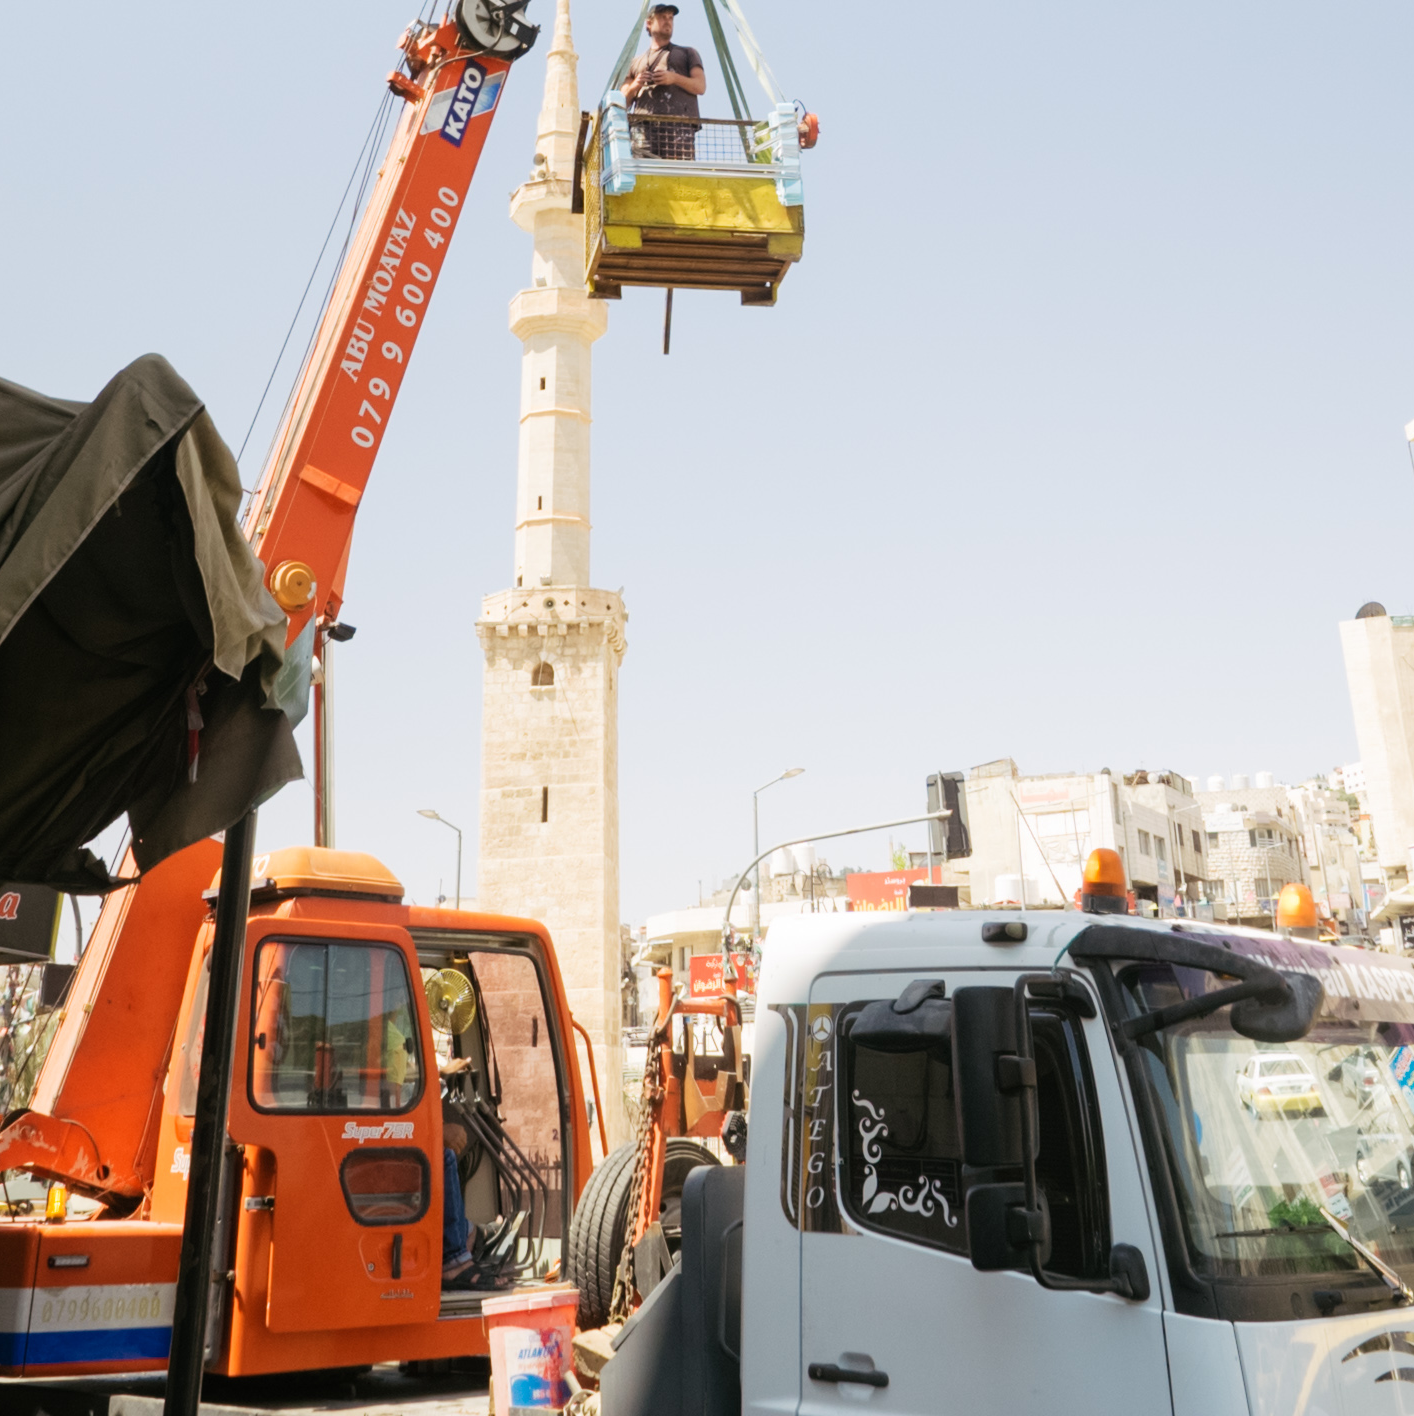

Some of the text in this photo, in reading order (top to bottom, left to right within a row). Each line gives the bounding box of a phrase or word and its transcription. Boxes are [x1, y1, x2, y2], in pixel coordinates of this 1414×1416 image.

[442, 68, 483, 141] KATO
[341, 206, 417, 384] ABU MOATAZ
[351, 185, 460, 448] 079 9 600 400
[806, 1050, 833, 1209] ATEGO
[41, 1296, 162, 1324] 0799600400
